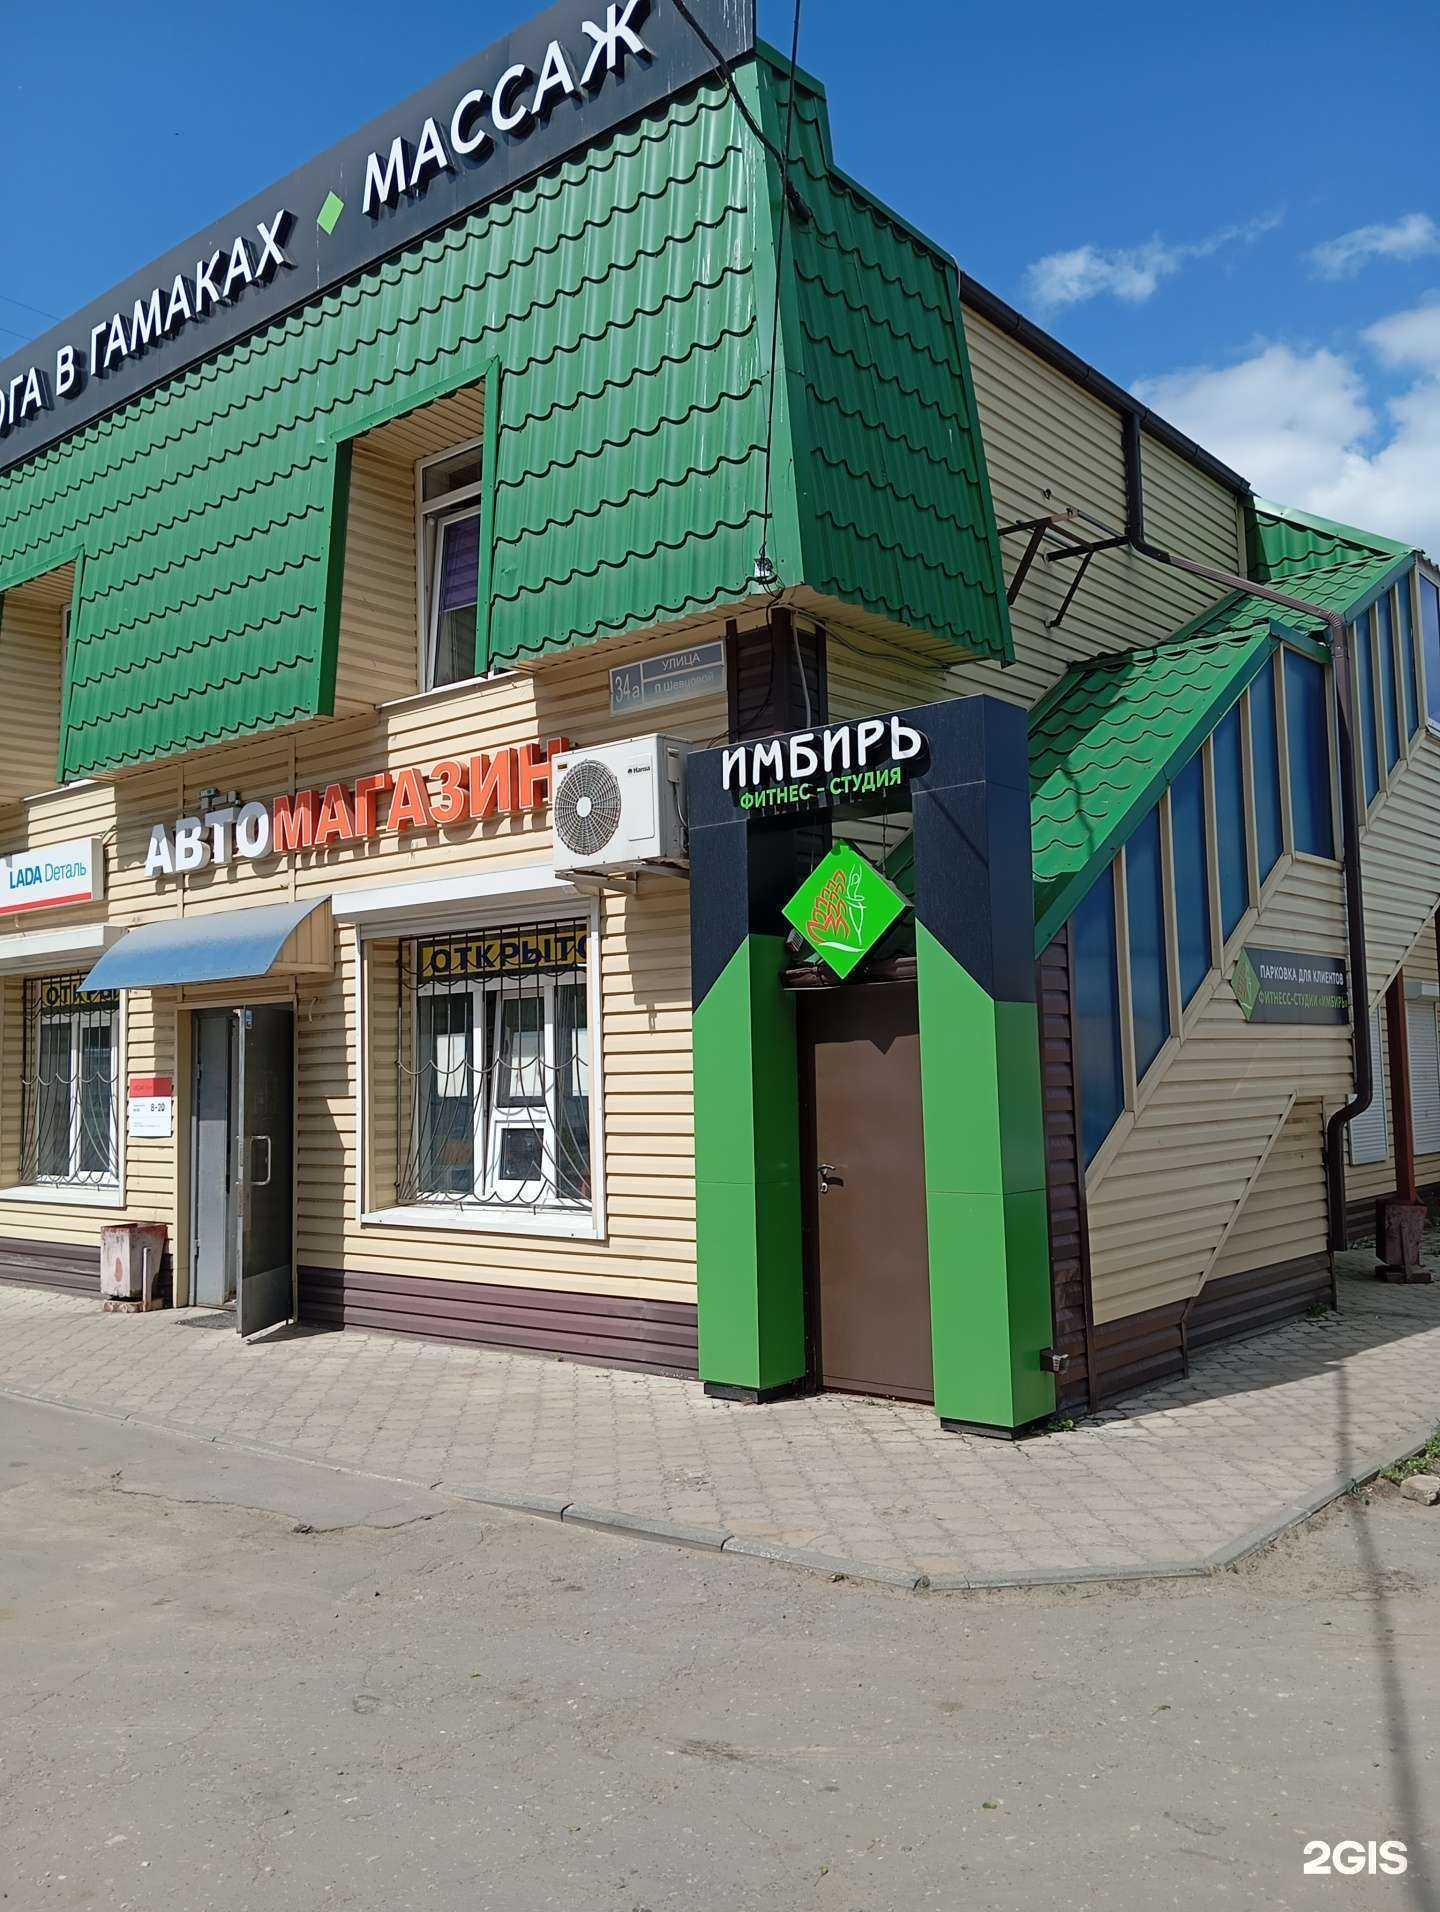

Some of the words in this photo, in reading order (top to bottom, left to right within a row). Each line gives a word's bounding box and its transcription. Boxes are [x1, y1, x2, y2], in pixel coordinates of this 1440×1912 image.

[56, 345, 76, 396] В
[90, 207, 286, 377] ГАМАКАХ
[362, 0, 645, 214] МАССАЖ
[662, 652, 701, 671] УЛИЦА
[722, 715, 922, 791] ИМБИРЬ
[144, 737, 568, 877] АВТОМАГАЗИН
[739, 782, 812, 810] ФИТНЕС
[829, 766, 902, 795] СТУДИЯ
[9, 865, 43, 889] LADA
[1260, 964, 1298, 981] ПАРКОВКА
[1298, 968, 1312, 983] ДЛЯ
[1313, 970, 1344, 986] КЛИЕНТОВ
